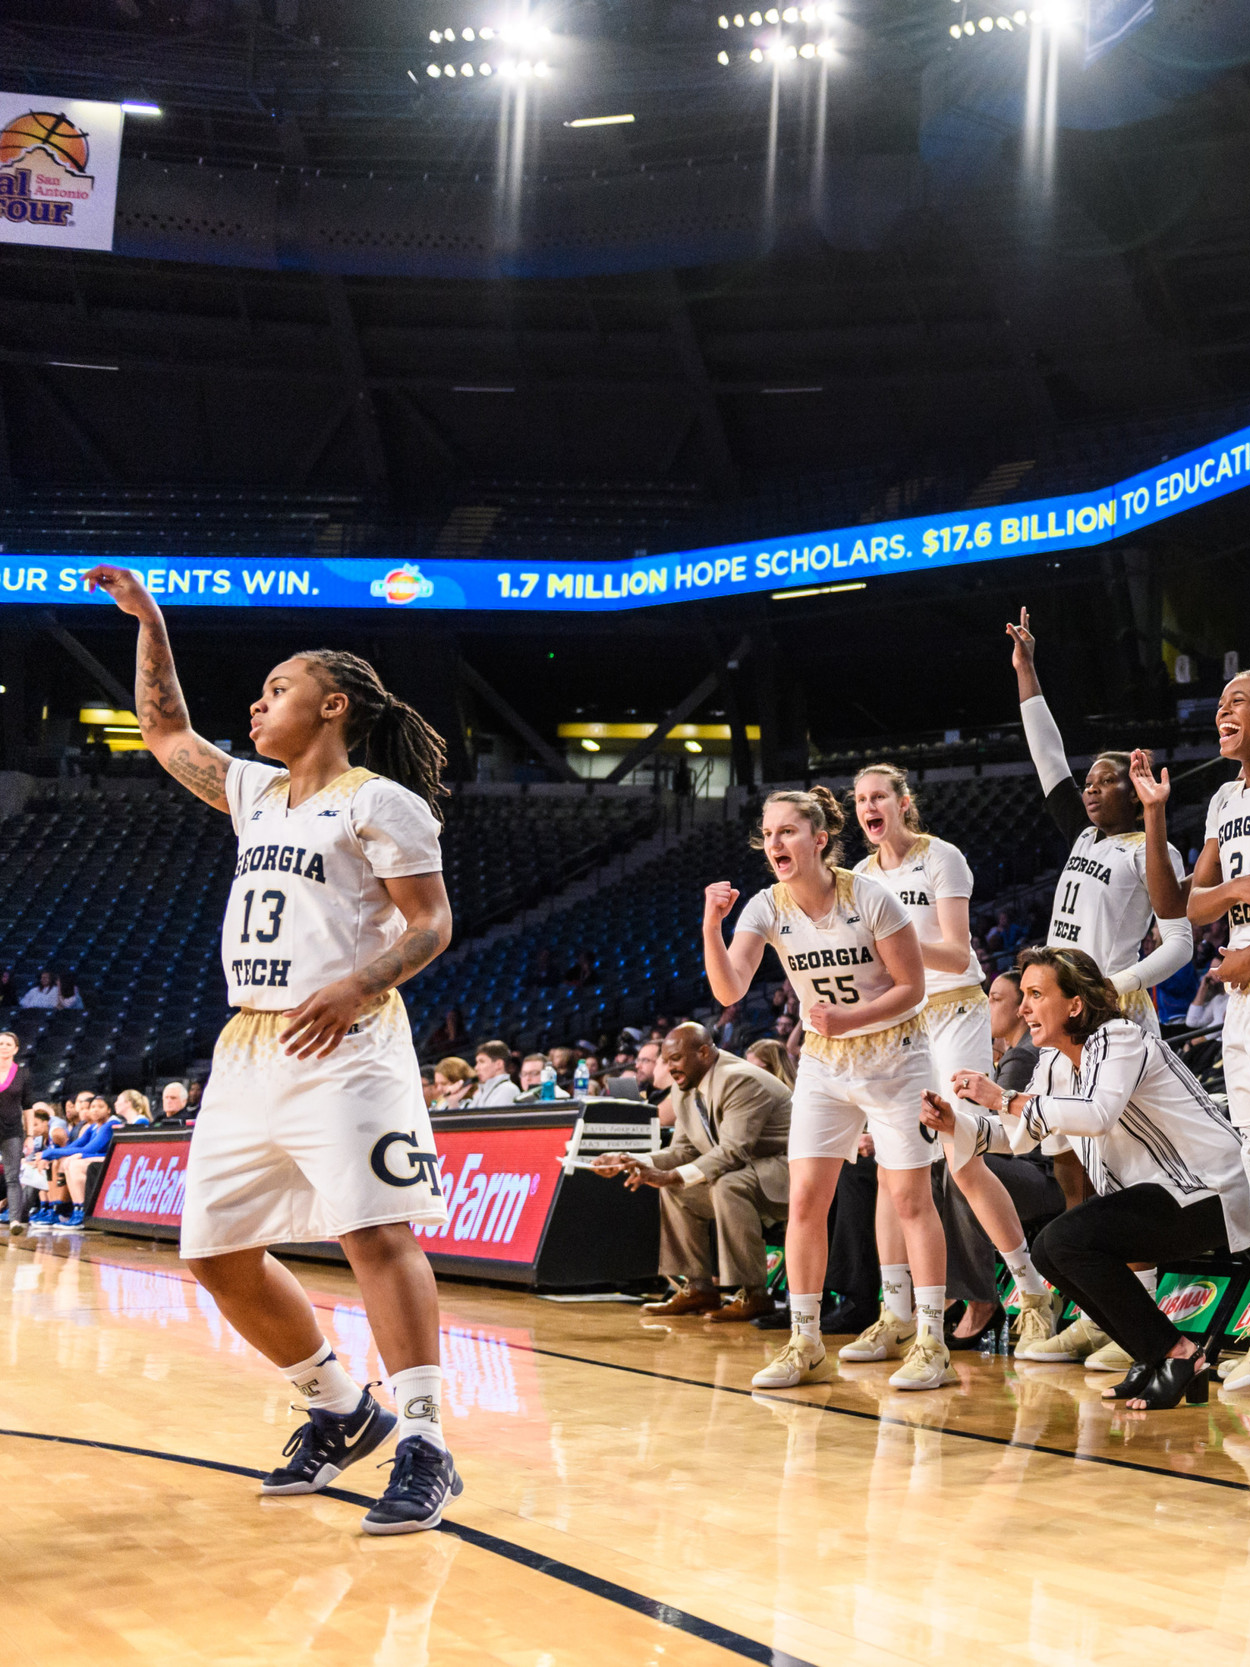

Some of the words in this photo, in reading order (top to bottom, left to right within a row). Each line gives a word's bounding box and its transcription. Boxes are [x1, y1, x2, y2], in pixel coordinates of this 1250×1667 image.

[34, 186, 89, 200] Antonio
[36, 174, 61, 186] San
[498, 573, 539, 598] 1.7
[547, 567, 667, 599] MILLION
[674, 556, 747, 590] HOPE
[755, 534, 912, 578] SCHOLARS.
[922, 521, 992, 558] $17.6
[1000, 499, 1118, 545] BILLION
[1121, 486, 1149, 519] TO
[0, 567, 48, 591] UR
[58, 569, 232, 594] STENTS
[242, 571, 319, 596] WIN.
[1061, 881, 1081, 914] 11
[240, 888, 287, 944] 13
[787, 945, 874, 971] GEORGIA
[232, 959, 292, 987] TECH
[811, 974, 860, 1004] 55
[369, 1130, 442, 1197] GT
